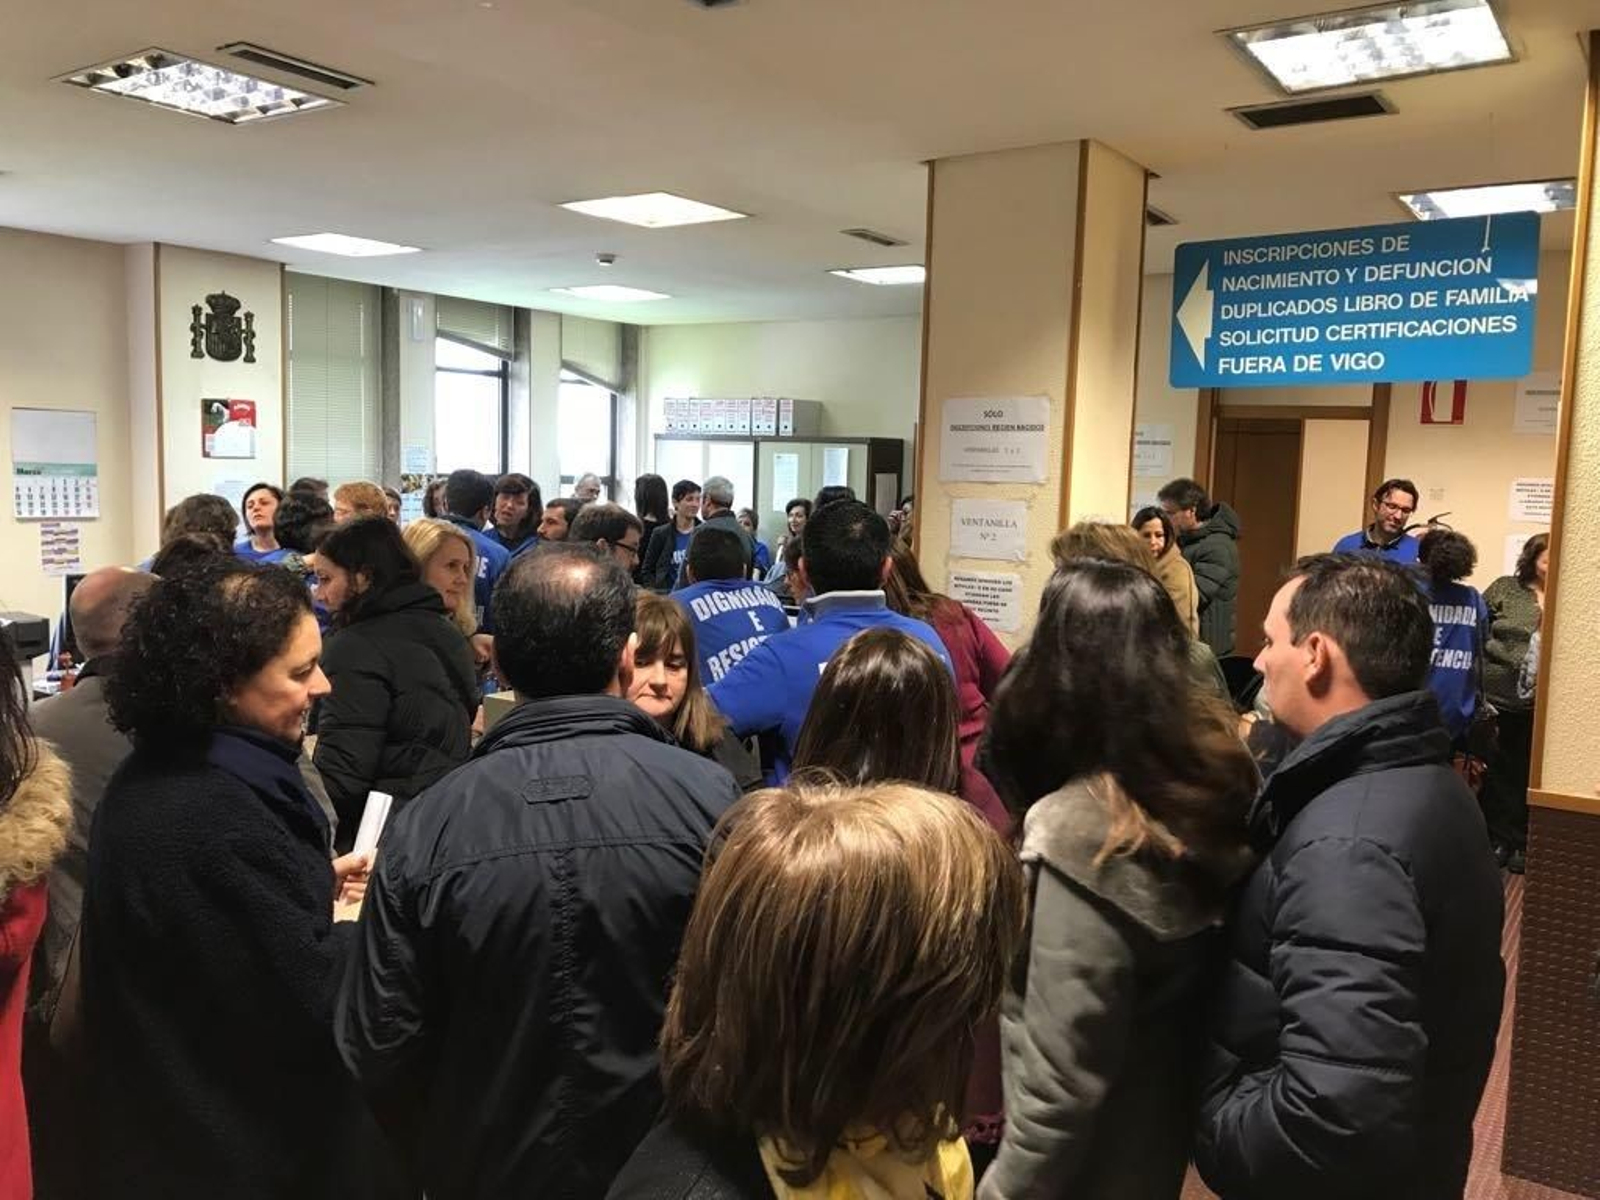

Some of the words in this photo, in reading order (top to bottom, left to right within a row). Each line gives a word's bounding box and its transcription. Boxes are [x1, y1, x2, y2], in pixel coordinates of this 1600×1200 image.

[1223, 240, 1374, 266] INSCRIPCIONES
[1381, 235, 1410, 254] DE
[1221, 267, 1340, 293] NACIMIENTO
[1345, 267, 1356, 283] Y
[1365, 257, 1492, 282] DEFUNCION
[1220, 297, 1338, 320] DUPLICADOS
[1344, 293, 1404, 313] LIBRO
[1411, 291, 1437, 309] DE
[1445, 286, 1529, 306] FAMILIA
[1219, 326, 1319, 347] SOLICITUD
[1326, 315, 1517, 341] CERTIFICACIONES
[1218, 355, 1286, 375] FUERA
[1294, 354, 1322, 373] DE
[1331, 351, 1385, 371] VIGO
[961, 518, 1018, 528] VENTANILLA
[748, 611, 764, 631] E
[1433, 626, 1443, 645] E
